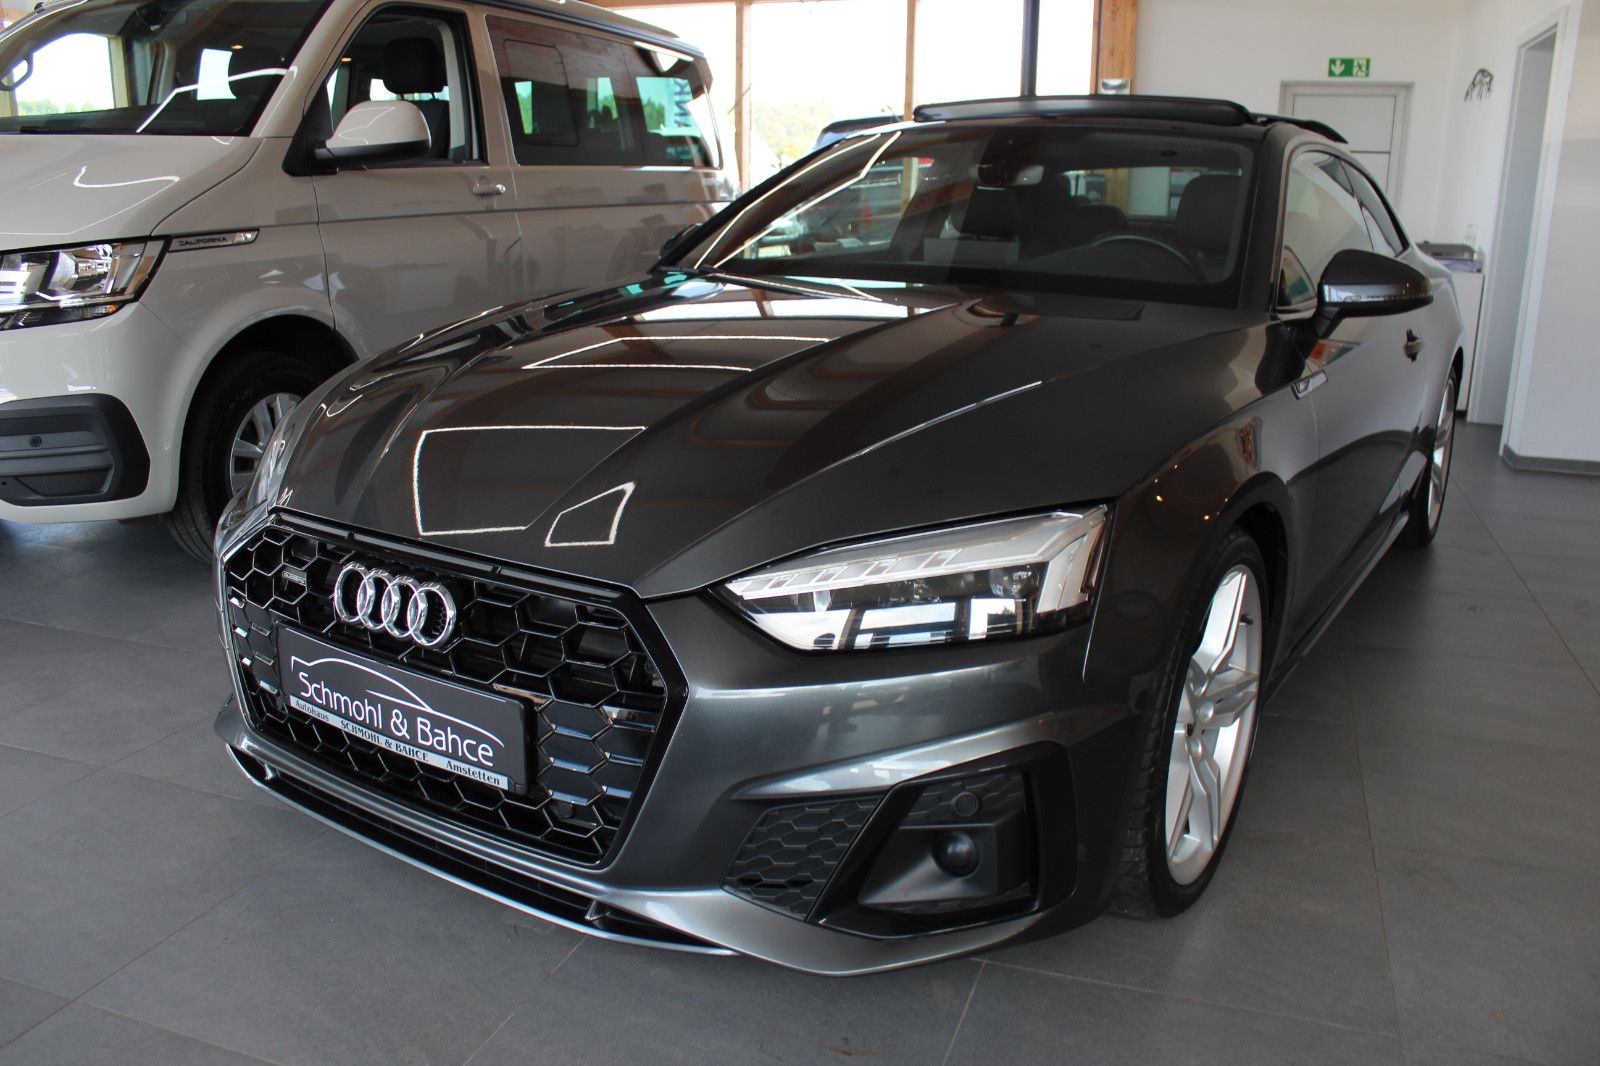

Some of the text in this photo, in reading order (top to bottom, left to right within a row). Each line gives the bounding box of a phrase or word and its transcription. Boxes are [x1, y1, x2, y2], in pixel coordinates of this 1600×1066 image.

[179, 236, 228, 247] CALIFORNIA
[295, 700, 501, 786] Autohaus SCHMOHL & BAHCE Amstetten
[299, 671, 494, 767] Schmohl & Bahce
